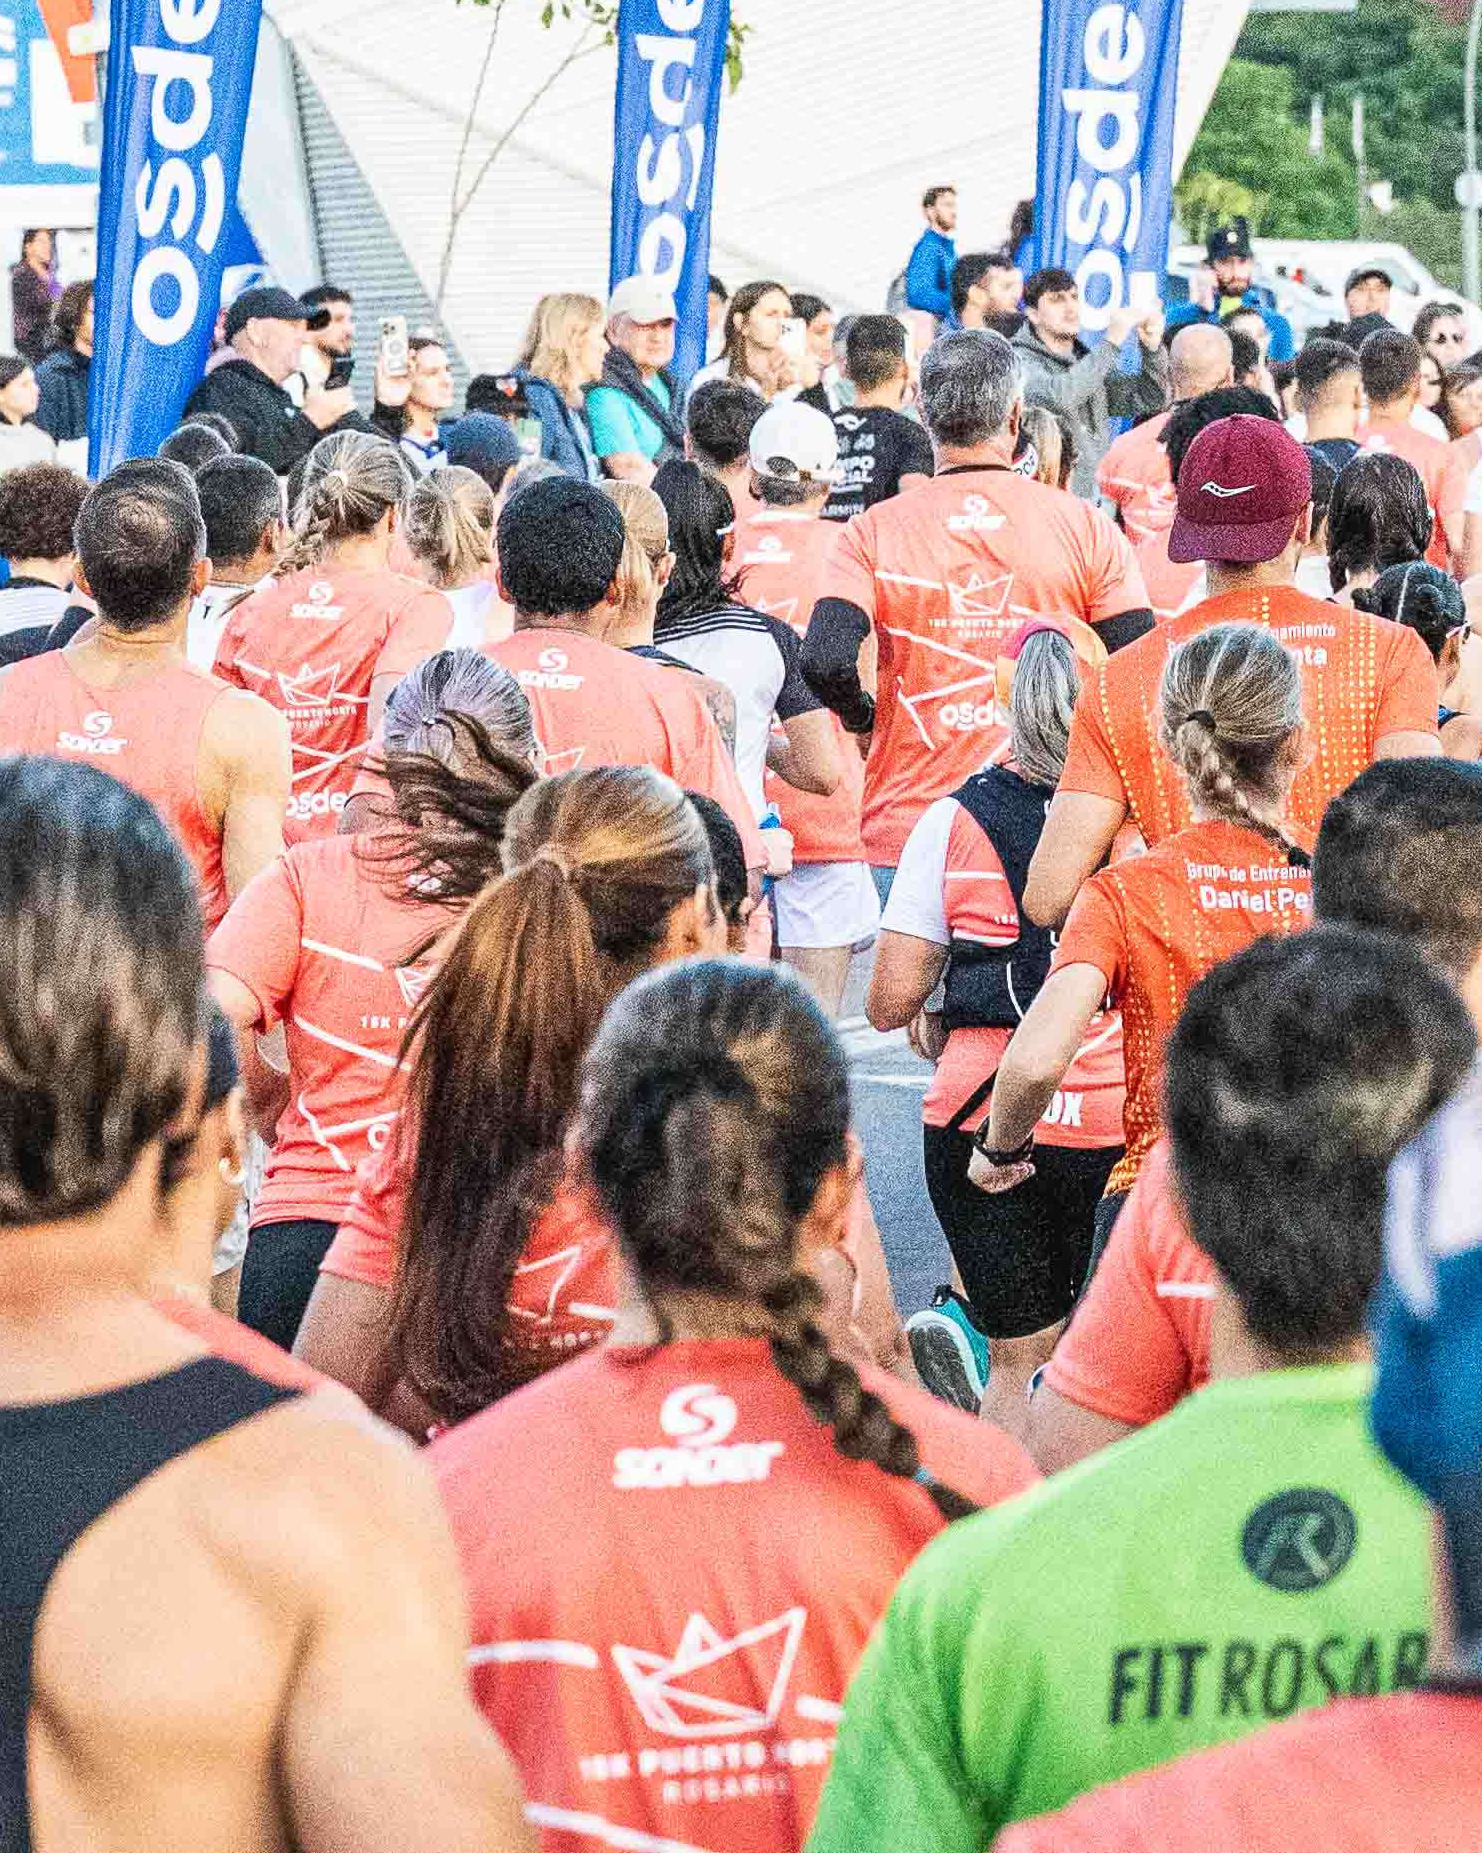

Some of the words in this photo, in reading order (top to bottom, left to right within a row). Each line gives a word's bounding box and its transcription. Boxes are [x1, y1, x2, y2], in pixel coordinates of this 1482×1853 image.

[1063, 3, 1145, 332] osde
[284, 792, 347, 819] osde
[1199, 886, 1271, 912] Daniel
[1277, 887, 1314, 911] Pe
